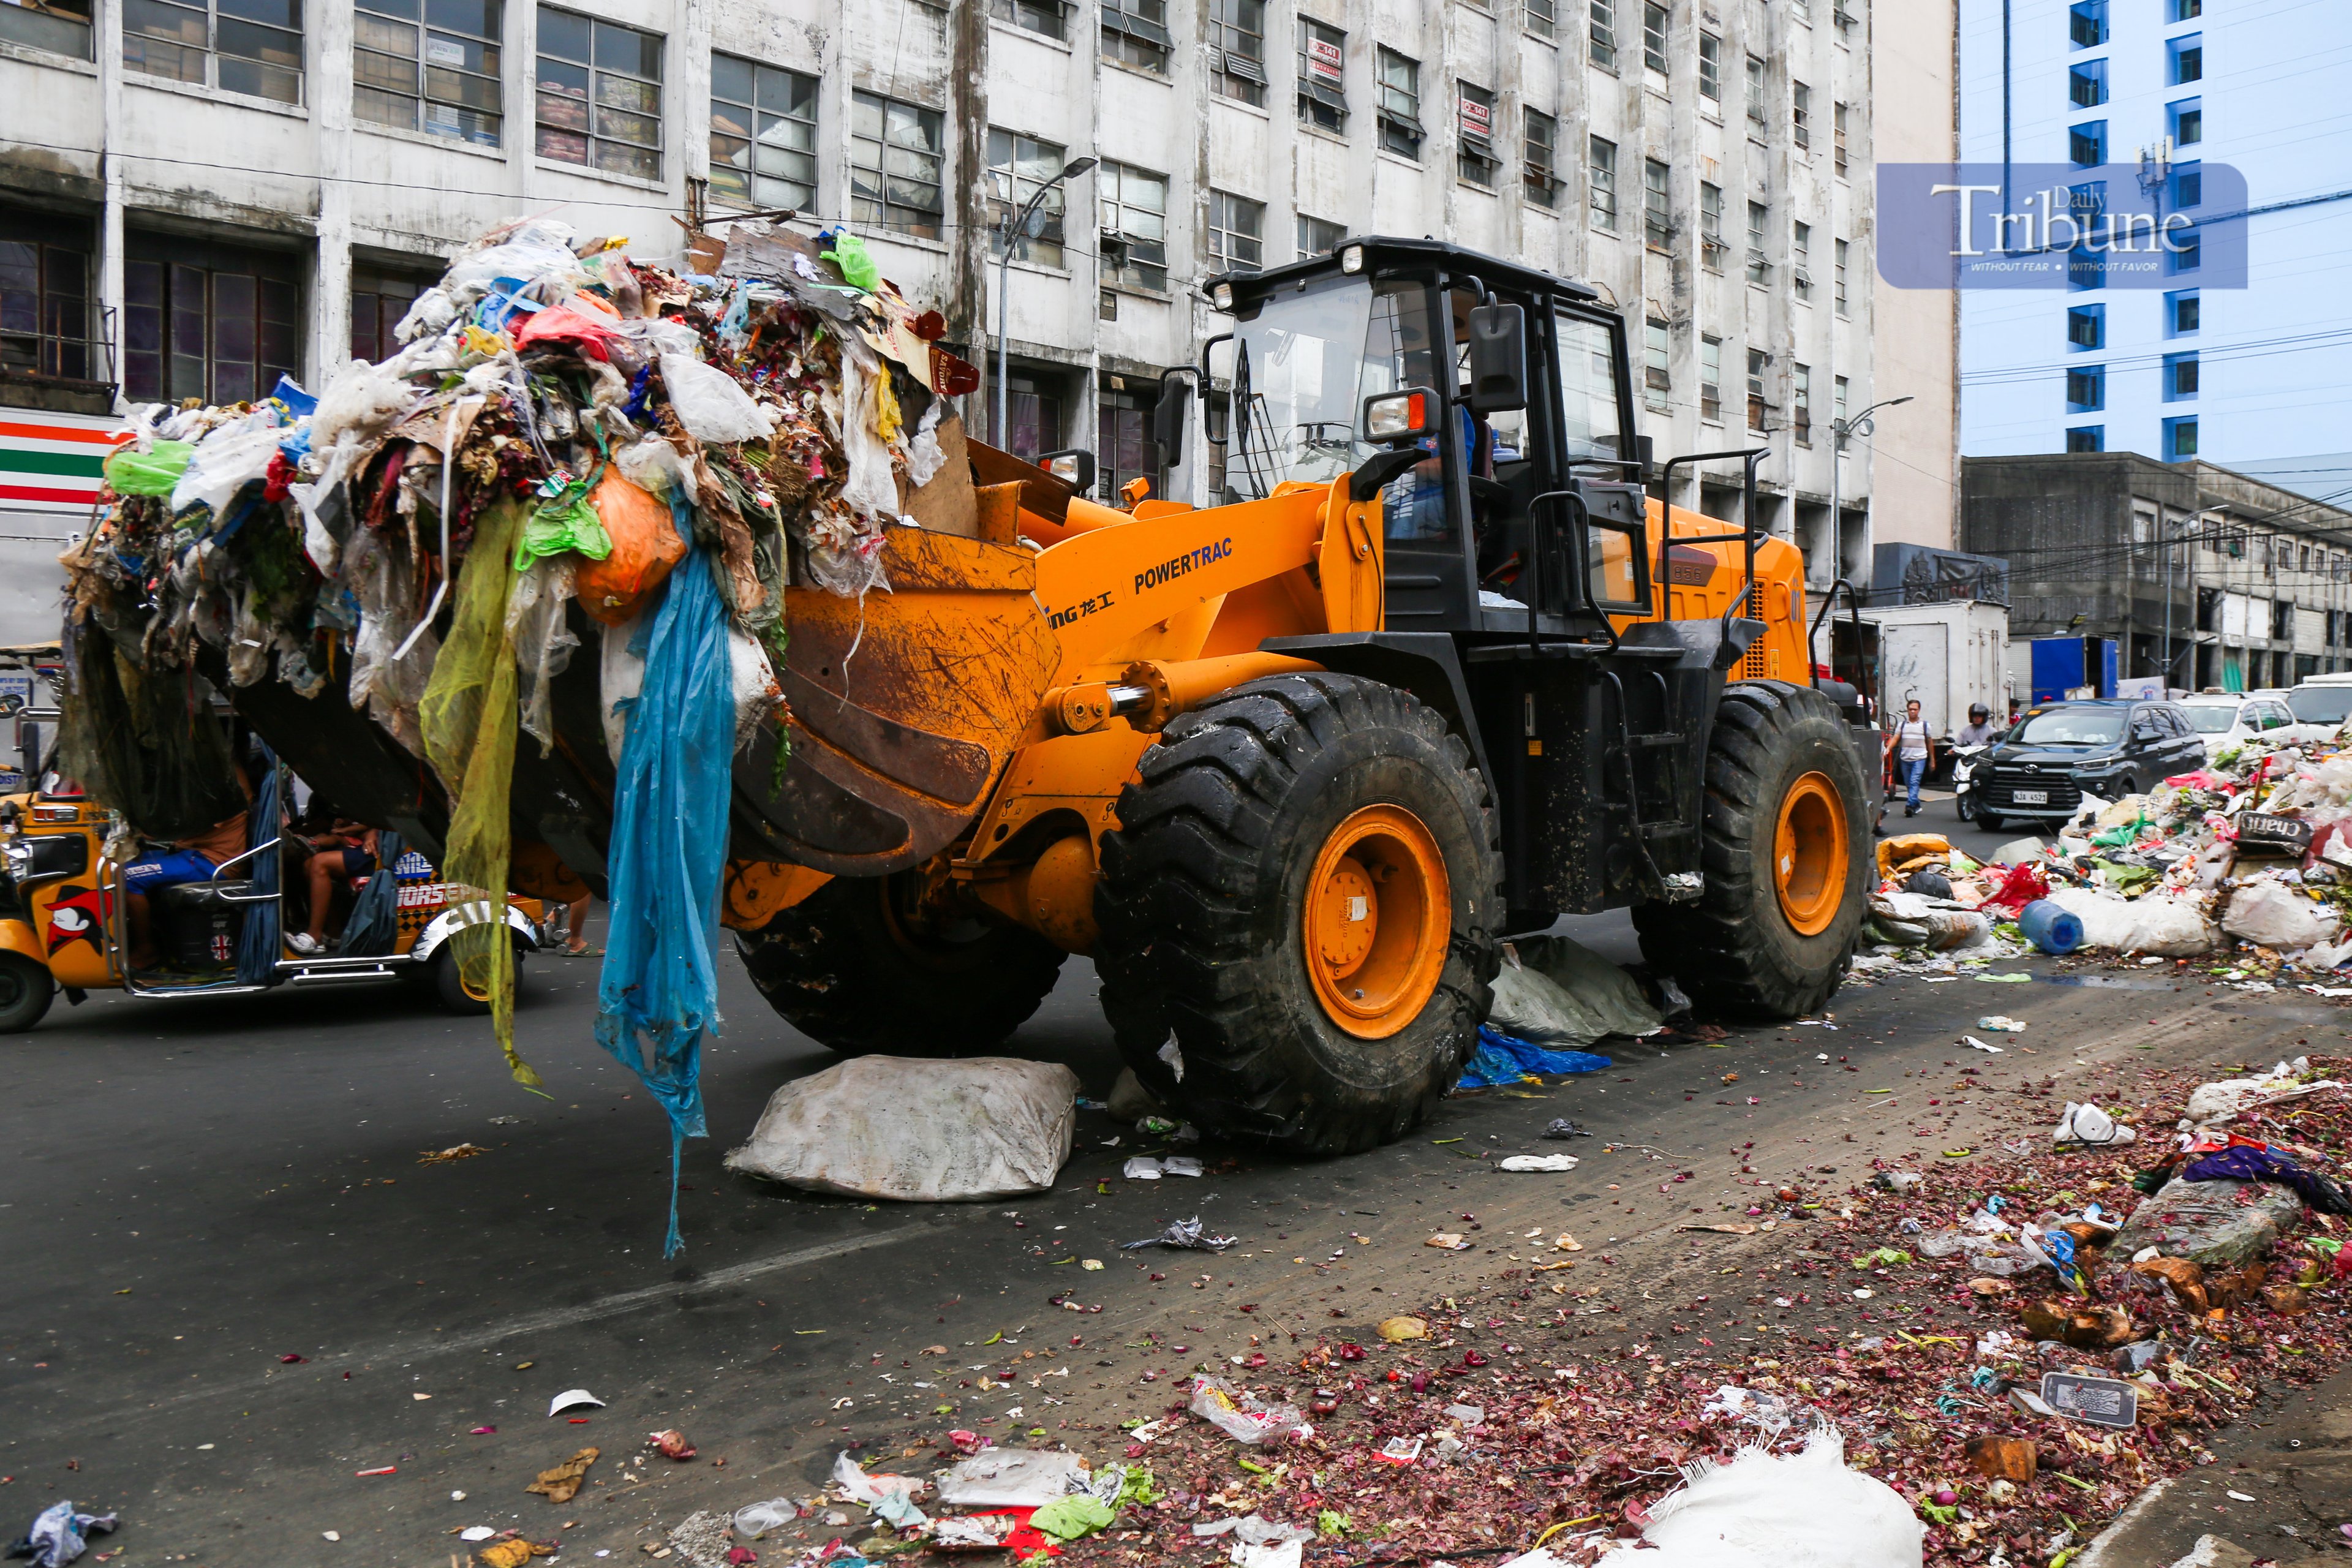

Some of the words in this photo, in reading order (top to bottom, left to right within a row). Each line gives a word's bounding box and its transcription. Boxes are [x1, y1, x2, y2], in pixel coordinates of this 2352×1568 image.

[1324, 46, 1336, 58] 141
[1475, 106, 1485, 116] 141
[938, 354, 949, 393] SAVORY
[1079, 590, 1115, 617] 龙工
[1134, 537, 1232, 595] POWERTRAC
[1674, 566, 1701, 581] 856
[1791, 589, 1801, 623] 01
